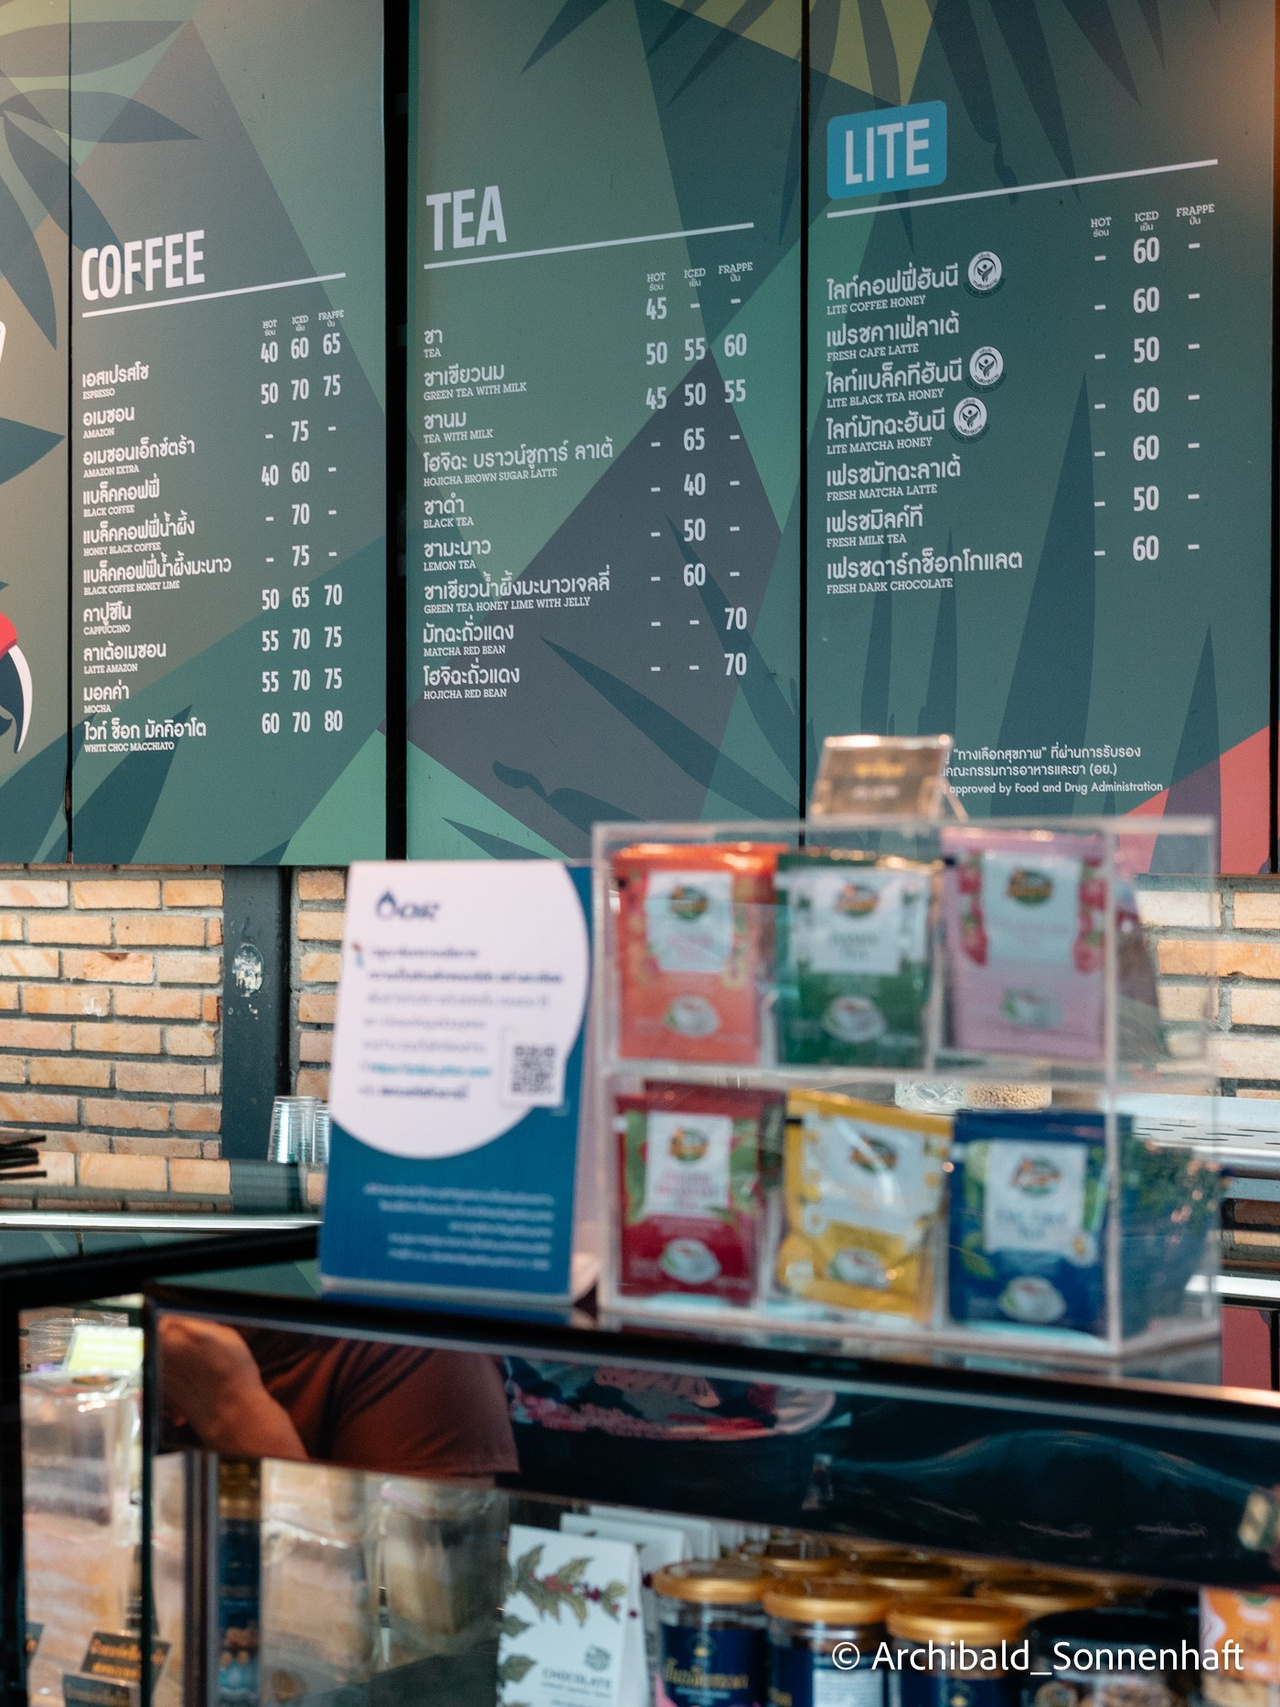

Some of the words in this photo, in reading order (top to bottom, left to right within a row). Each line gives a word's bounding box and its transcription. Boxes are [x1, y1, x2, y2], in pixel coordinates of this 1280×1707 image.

[846, 119, 929, 184] LITE
[426, 186, 507, 251] TEA
[1091, 217, 1111, 228] HOT
[1135, 211, 1159, 222] ICED
[1177, 204, 1214, 218] FRAPPE
[1134, 237, 1159, 263] 60
[82, 230, 206, 301] COFFEE
[647, 272, 666, 282] HOT
[684, 268, 706, 280] ICED
[719, 262, 753, 276] FRAPPE
[646, 297, 666, 320] 45
[827, 305, 847, 315] LITE
[850, 300, 888, 312] COFFEE
[890, 295, 926, 307] HONEY
[1134, 287, 1159, 313] 60
[263, 319, 277, 328] HOT
[292, 315, 308, 325] ICED
[318, 310, 344, 321] FRAPPE
[827, 309, 959, 349] เฟรชคาเฟ่ลาเต้
[261, 342, 278, 363] 40
[291, 337, 309, 359] 60
[323, 333, 340, 354] 65
[424, 329, 442, 344] ชา
[424, 348, 441, 358] TEA
[647, 342, 667, 365] 50
[685, 337, 705, 361] 55
[724, 333, 746, 357] 60
[827, 350, 856, 362] FRESH
[859, 347, 886, 358] CAFE
[889, 343, 919, 355] LATTE
[1134, 337, 1159, 363] 50
[83, 361, 149, 387] เอสเปรสโซ
[424, 364, 506, 388] ชาเขียวนม
[83, 388, 115, 399] ESPRESSO
[261, 383, 278, 404] 50
[291, 379, 309, 400] 70
[324, 375, 340, 396] 75
[424, 389, 453, 400] GREEN
[456, 388, 474, 397] TEA
[476, 385, 500, 395] WITH
[503, 382, 527, 393] MILK
[646, 386, 666, 409] 45
[685, 383, 706, 406] 50
[725, 379, 746, 403] 55
[827, 398, 847, 408] LITE
[850, 394, 883, 406] BLACK
[886, 392, 905, 402] TEA
[908, 388, 944, 400] HONEY
[1133, 387, 1159, 413] 60
[83, 407, 134, 426] อเมซอน
[424, 412, 466, 430] ชานม
[83, 427, 114, 439] AMAZON
[292, 420, 308, 442] 75
[423, 434, 441, 443] TEA
[443, 431, 467, 441] WITH
[470, 429, 493, 439] MILK
[684, 428, 705, 451] 65
[83, 435, 194, 465] อเมซอนเอ็กซ์ตร้า
[423, 452, 467, 472] โฮจิฉะ
[575, 436, 612, 460] ลาเต้
[827, 444, 847, 454] LITE
[850, 440, 894, 452] MATCHA
[897, 437, 932, 448] HONEY
[1133, 435, 1159, 461] 60
[262, 465, 278, 486] 40
[292, 461, 309, 483] 60
[827, 454, 960, 488] เฟรชมัทฉะลาเต้
[83, 473, 159, 505] แบล็คคอฟฟี่
[684, 473, 705, 496] 40
[827, 490, 856, 501] FRESH
[859, 487, 904, 499] MATCHA
[907, 484, 937, 495] LATTE
[424, 492, 464, 515] ชาดำ
[1134, 486, 1159, 511] 50
[84, 507, 107, 517] BLACK
[108, 505, 134, 515] COFFEE
[292, 503, 309, 525] 70
[424, 518, 454, 528] BLACK
[456, 517, 474, 526] TEA
[827, 504, 922, 533] เฟรชมิลค์ที
[684, 518, 705, 541] 50
[827, 537, 856, 548] FRESH
[859, 535, 884, 545] MILK
[887, 533, 907, 543] TEA
[292, 545, 309, 566] 75
[424, 540, 491, 557] ชามะนาว
[1133, 536, 1159, 561] 60
[424, 561, 456, 571] LEMON
[458, 560, 476, 569] TEA
[684, 563, 705, 586] 60
[262, 589, 279, 610] 50
[292, 587, 309, 608] 65
[324, 584, 342, 605] 70
[827, 584, 856, 594] FRESH
[859, 582, 887, 592] DARK
[890, 578, 953, 591] CHOCOLATE
[424, 615, 513, 643] มัทฉะถั่วแดง
[725, 607, 747, 630] 70
[262, 630, 278, 651] 55
[292, 628, 310, 649] 70
[325, 626, 342, 647] 75
[84, 641, 166, 661] ลาเต้อเมซอน
[724, 653, 746, 675] 70
[84, 679, 129, 701] มอคค่า
[262, 671, 279, 692] 55
[293, 669, 310, 690] 70
[325, 668, 342, 689] 75
[84, 704, 111, 713] MOCHA
[84, 721, 107, 740] ไวท์
[112, 717, 140, 739] ช็อก
[145, 717, 206, 738] มัคคิอาโต
[262, 713, 279, 734] 60
[293, 712, 310, 732] 70
[325, 710, 342, 731] 80
[949, 782, 995, 797] approved
[999, 783, 1011, 796] by
[1015, 782, 1039, 792] Food
[1043, 782, 1061, 792] and
[1065, 783, 1087, 795] Drug
[1091, 781, 1163, 791] Administration
